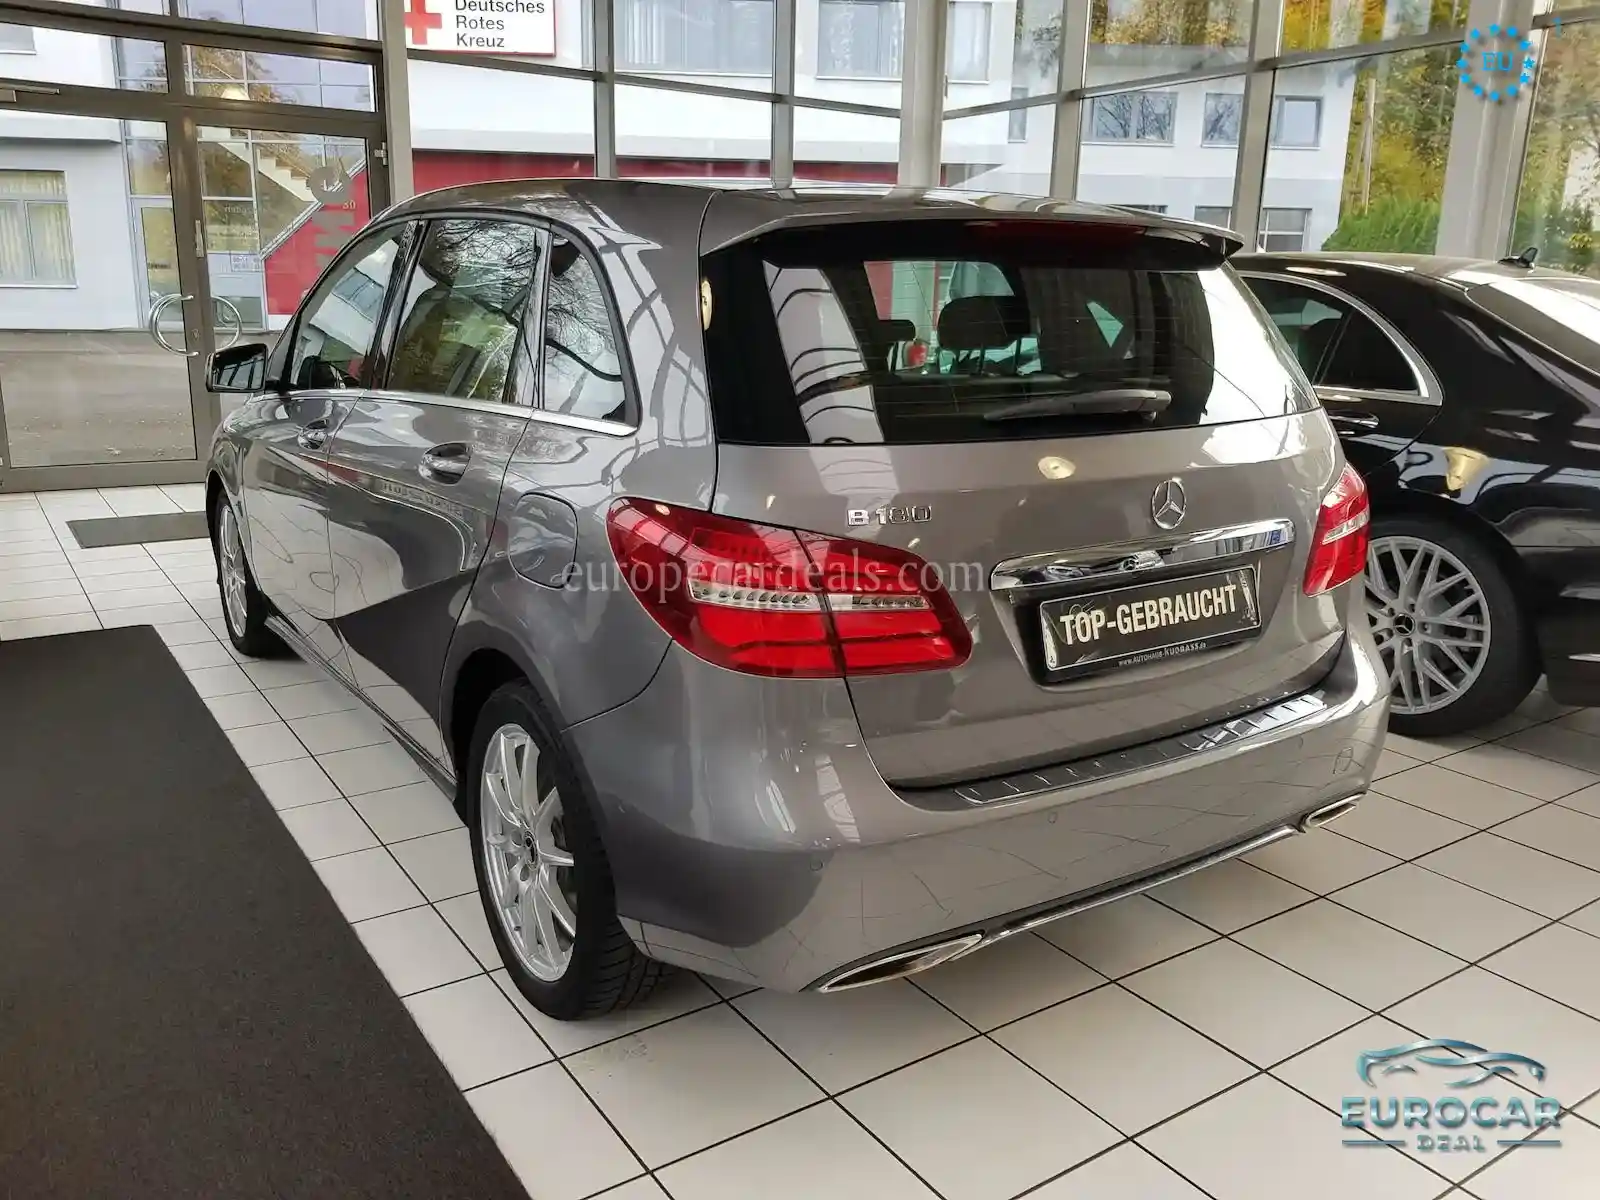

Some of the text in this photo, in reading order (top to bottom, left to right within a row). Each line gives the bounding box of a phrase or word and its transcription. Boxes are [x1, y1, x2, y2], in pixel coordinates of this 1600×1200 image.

[455, 0, 545, 13] Deutsches
[456, 15, 505, 30] Rotes
[456, 33, 505, 48] Kreuz
[847, 503, 933, 526] B 180
[1060, 584, 1237, 646] TOP-GEBRAUCHT
